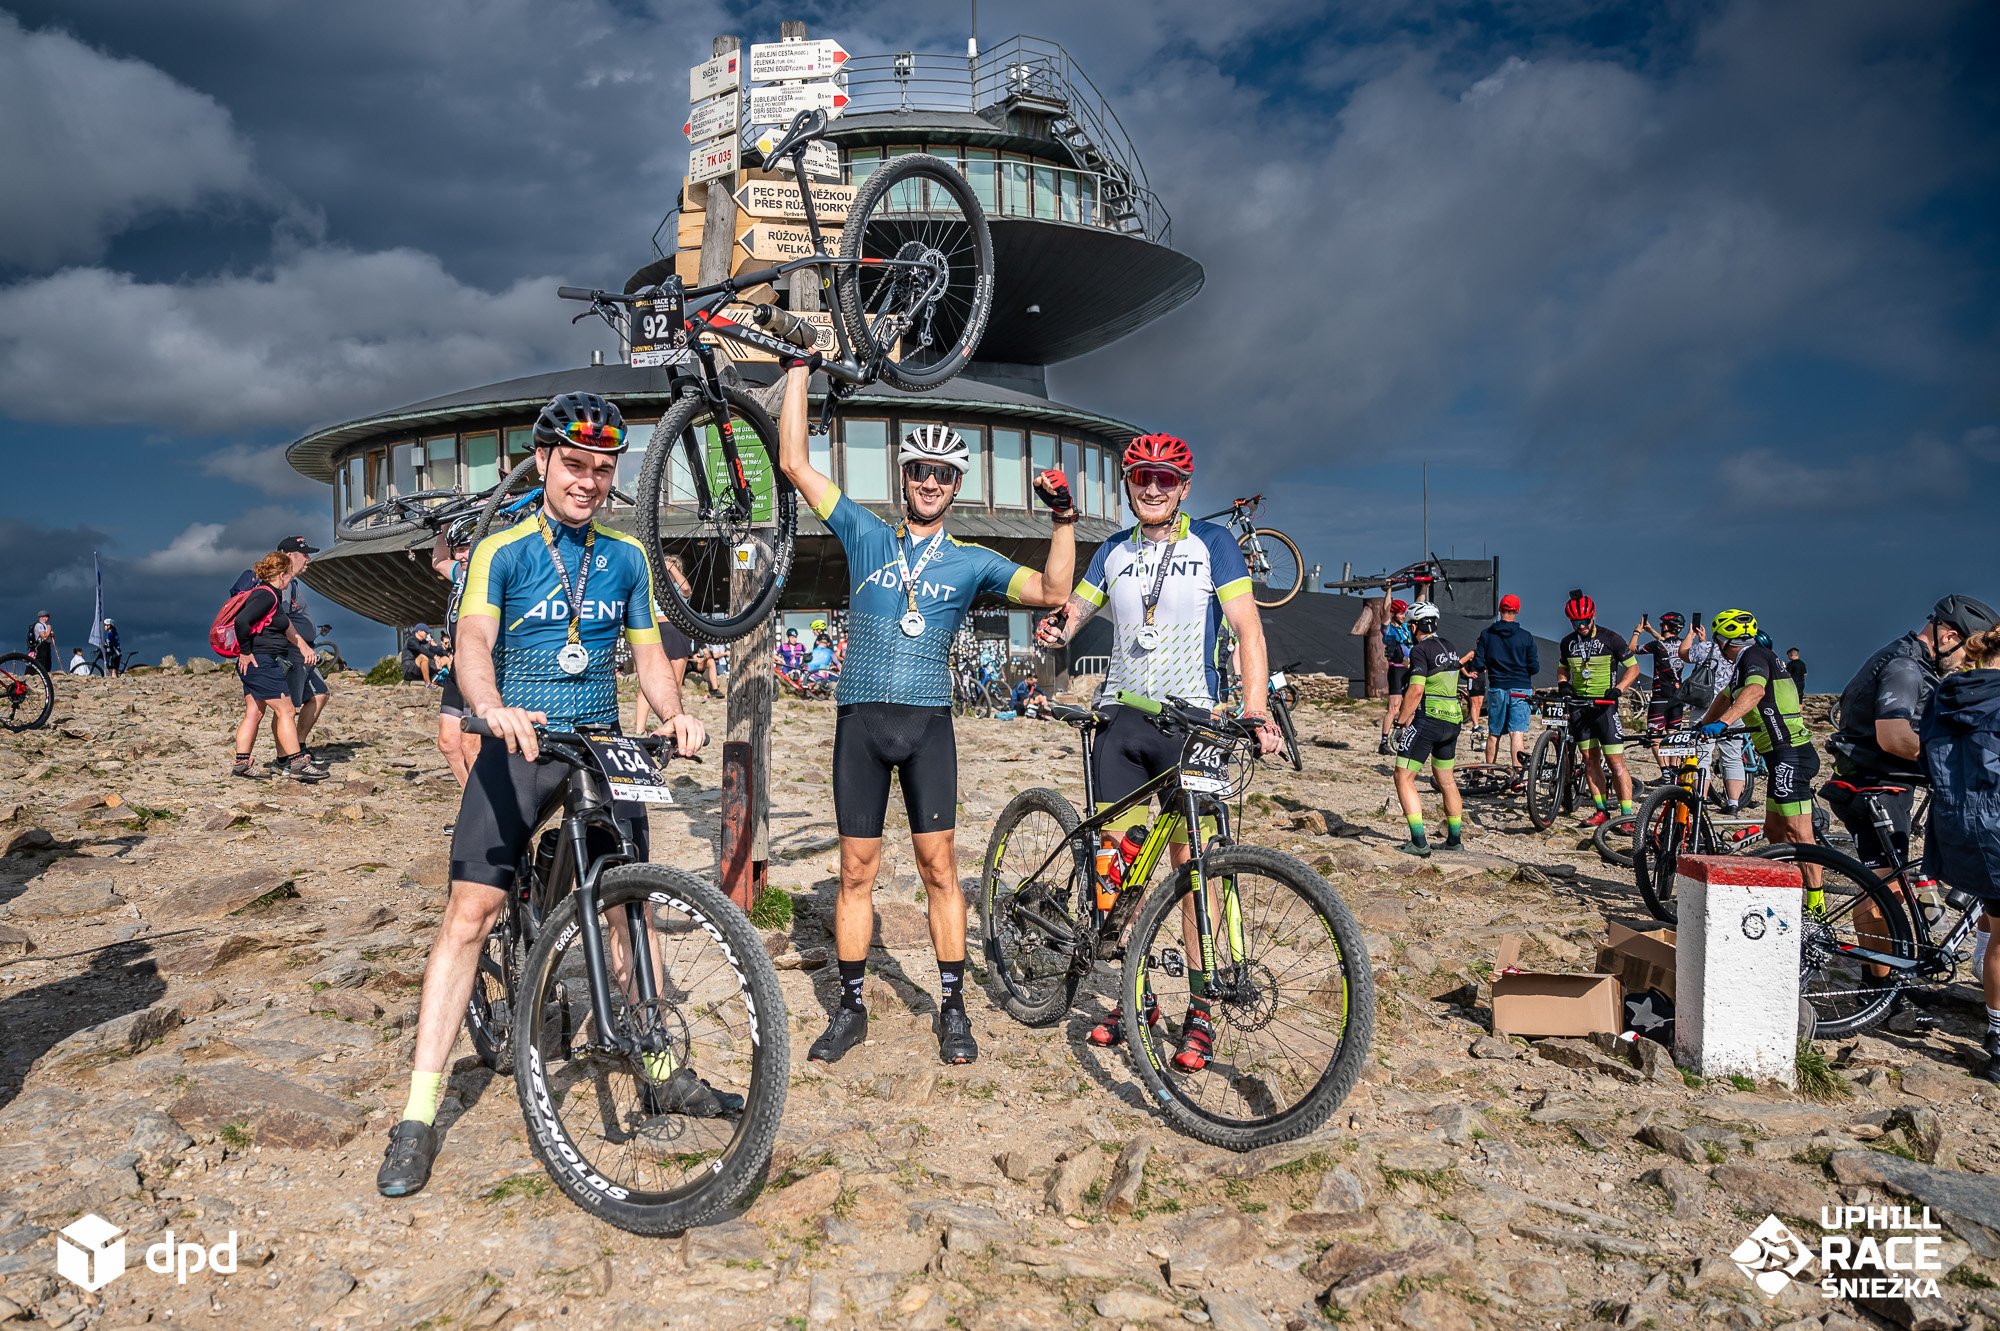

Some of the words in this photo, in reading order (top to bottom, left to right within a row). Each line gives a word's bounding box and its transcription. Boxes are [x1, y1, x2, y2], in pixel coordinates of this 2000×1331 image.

[753, 50, 777, 58] JUBILEJNÍ
[753, 58, 775, 66] JELENKA
[753, 95, 777, 103] JUBILEJNÍ
[753, 107, 766, 115] OBŘÍ
[706, 155, 717, 168] TK
[717, 149, 732, 163] 035
[753, 187, 774, 197] PEC
[777, 189, 799, 198] POD
[810, 189, 852, 201] NĚŽKOU
[754, 198, 782, 209] PŘES
[768, 230, 812, 243] RŮŽOVÁ
[776, 244, 811, 254] VELKÁ
[968, 274, 991, 348] SCHWALBE
[643, 314, 669, 340] 92
[780, 492, 795, 576] SCHWALBE
[773, 562, 780, 575] DT
[524, 600, 626, 621] ADENT
[1546, 707, 1563, 716] 178
[1668, 733, 1691, 743] 188
[606, 748, 650, 774] 134
[1188, 742, 1225, 769] 245
[556, 921, 580, 951] TR249
[1318, 913, 1343, 961] BONTRAGER
[1201, 934, 1212, 971] ROCKSHOX
[648, 891, 760, 1047] REYNOLDS
[1139, 1025, 1160, 1070] BONTRAGER
[530, 1044, 629, 1201] REYNOLDS
[1168, 1100, 1255, 1139] SCHWALBE
